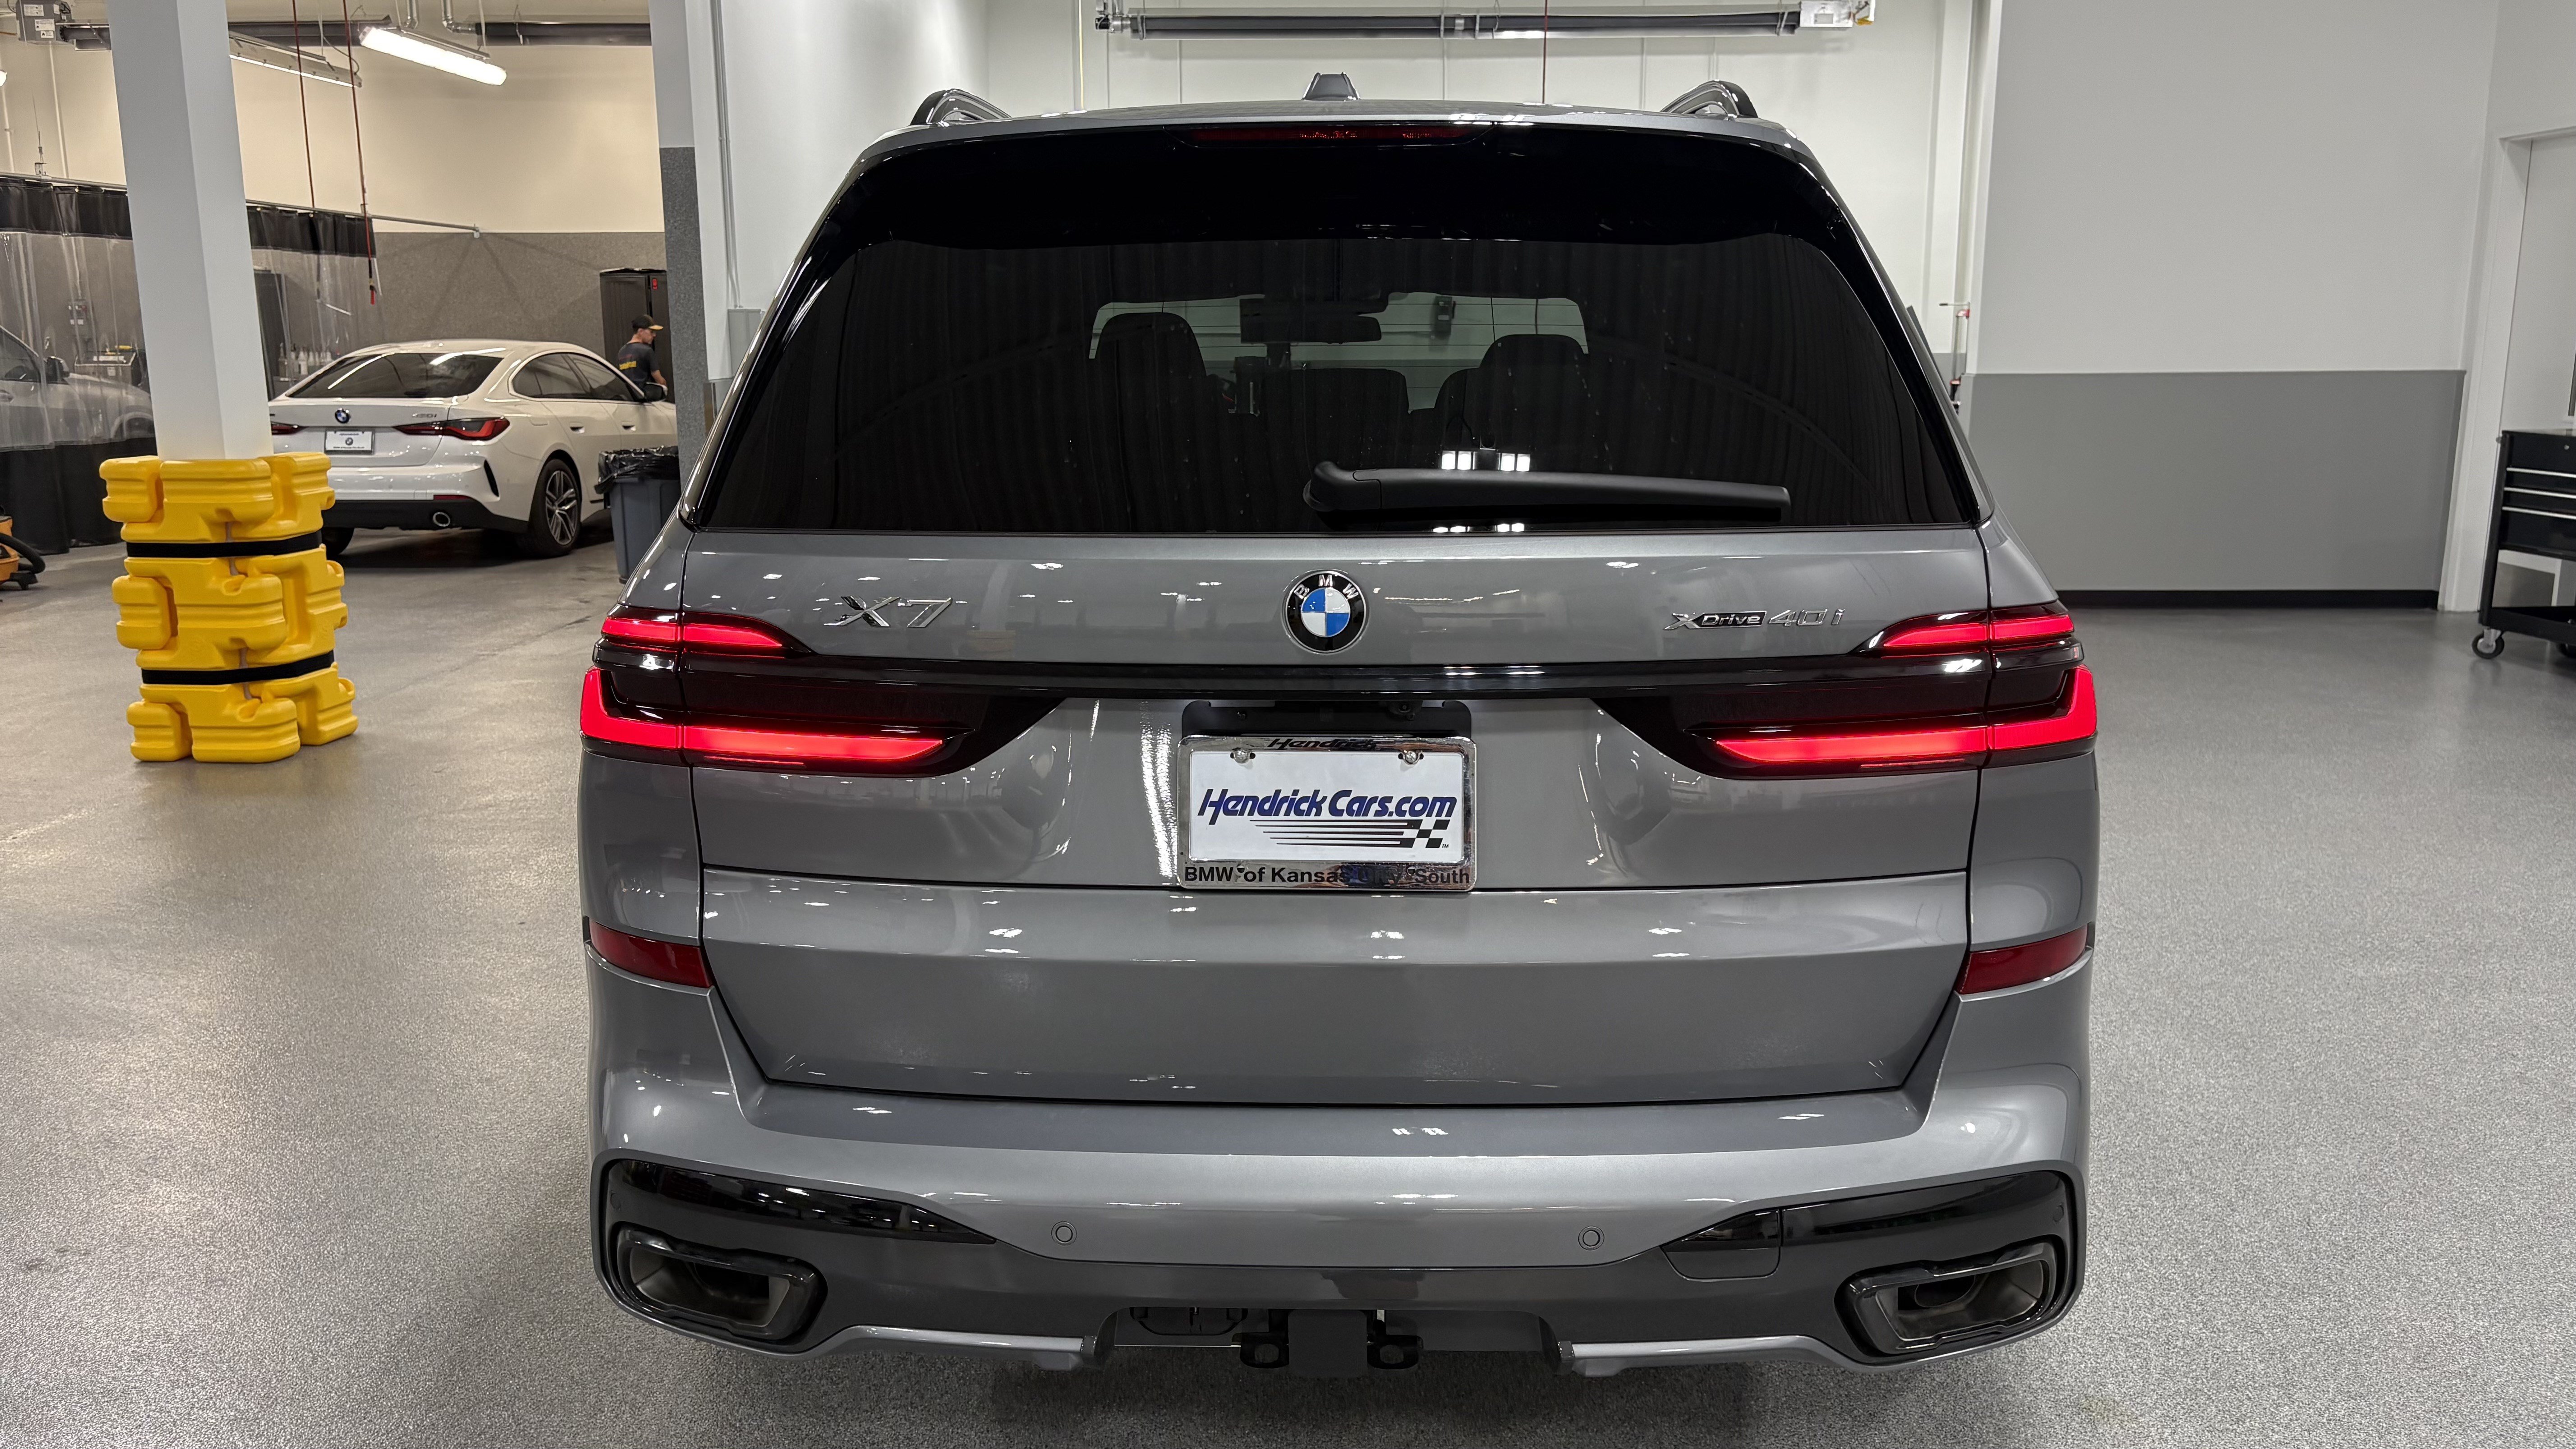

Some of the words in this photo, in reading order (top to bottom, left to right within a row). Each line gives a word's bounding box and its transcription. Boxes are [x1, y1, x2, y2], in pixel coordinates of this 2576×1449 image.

[1294, 574, 1359, 599] BMW
[823, 596, 952, 628] X7
[1769, 609, 1846, 626] 40i
[1267, 738, 1376, 750] Hendrick
[1185, 866, 1234, 882] BMW
[1243, 867, 1265, 882] of
[1271, 867, 1349, 883] Kansas
[1415, 868, 1470, 884] South
